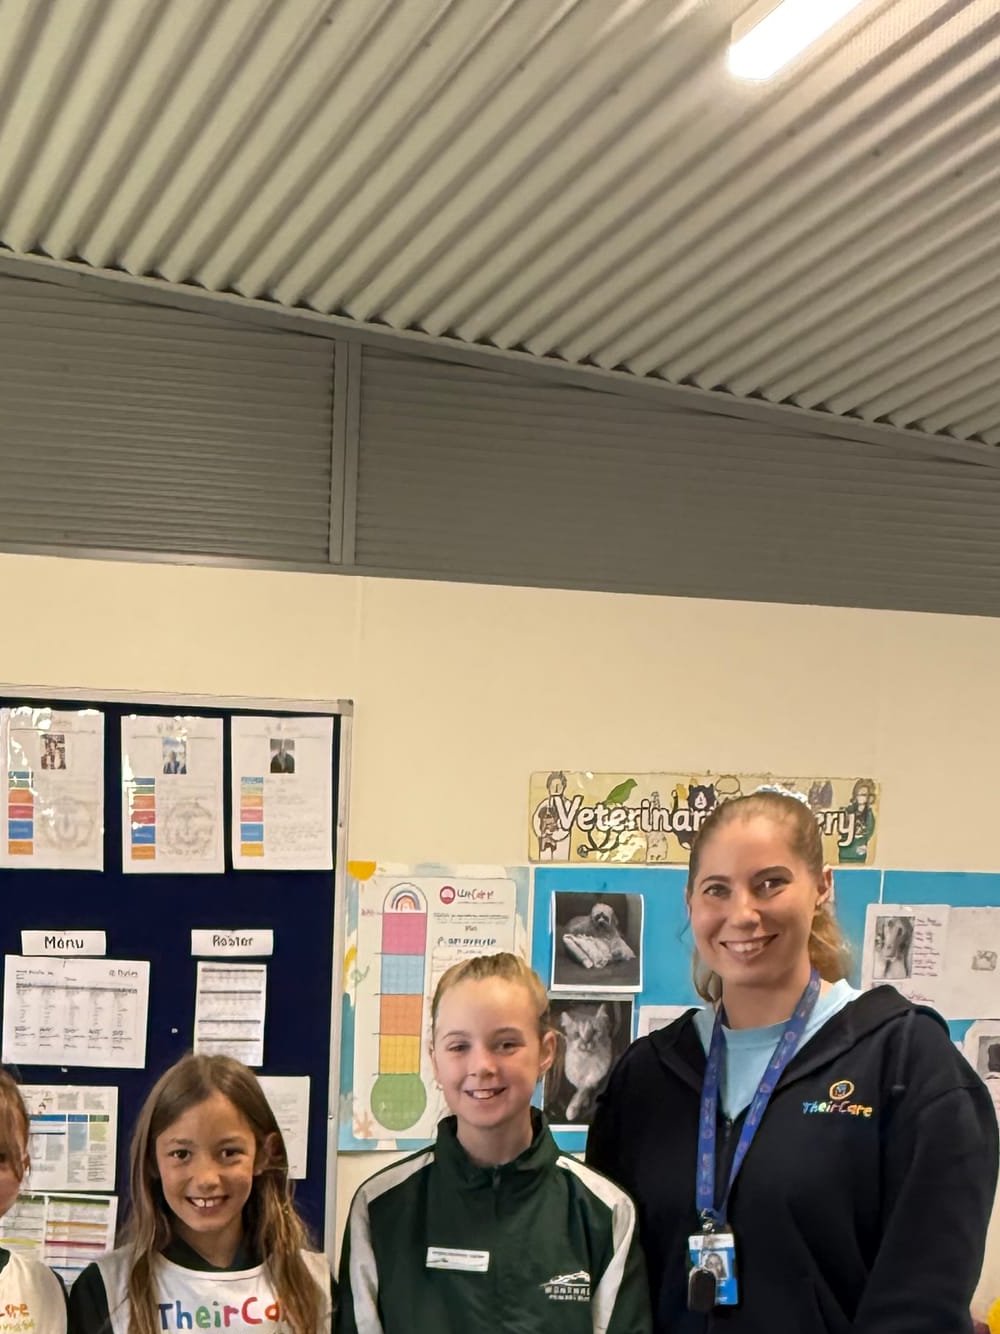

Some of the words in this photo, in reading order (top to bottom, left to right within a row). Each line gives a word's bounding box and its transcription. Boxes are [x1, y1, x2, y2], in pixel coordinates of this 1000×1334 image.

[553, 794, 713, 833] Veterinar
[44, 935, 84, 950] Menu
[157, 1296, 281, 1330] TheirCa
